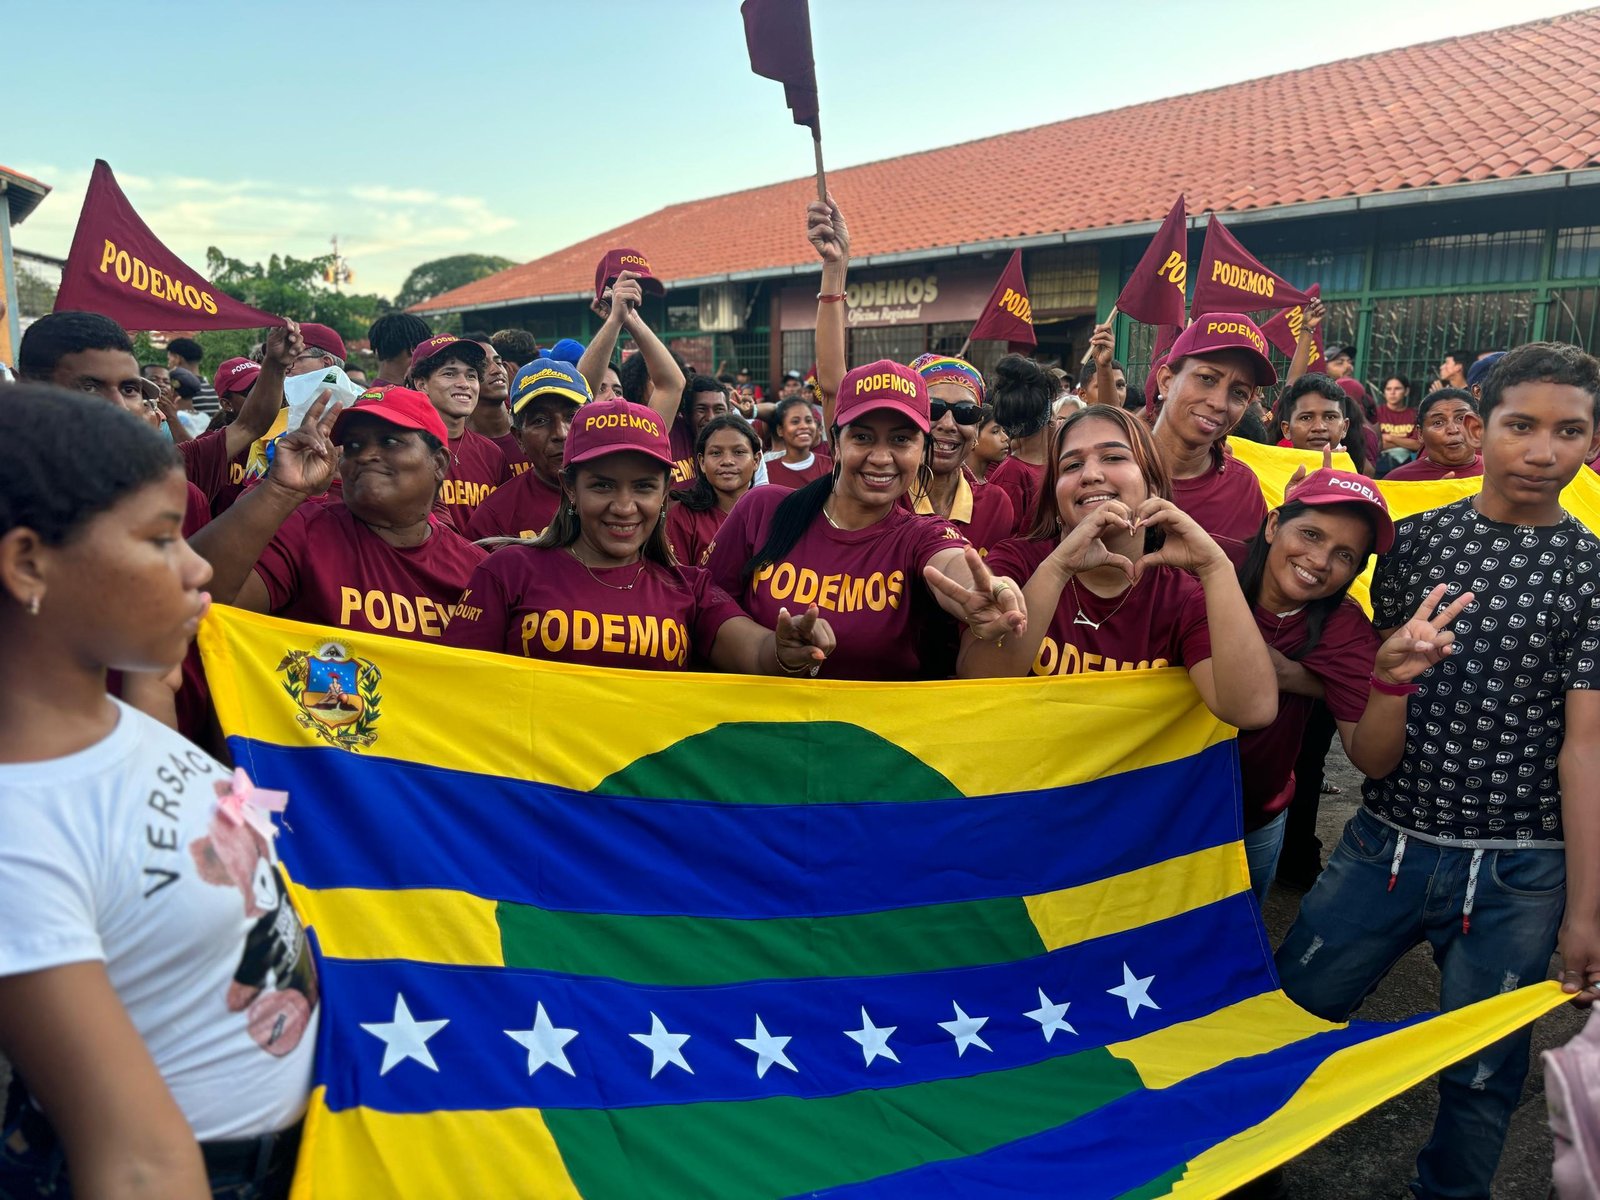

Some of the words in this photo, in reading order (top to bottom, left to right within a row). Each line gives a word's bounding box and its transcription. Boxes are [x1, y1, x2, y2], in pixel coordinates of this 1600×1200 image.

[100, 239, 218, 315] PODEMOS
[846, 275, 939, 309] ODEMOS
[1211, 259, 1275, 298] PODEMOS
[1206, 322, 1265, 353] PODEMOS
[855, 373, 917, 398] PODEMOS
[585, 413, 660, 437] PODEMOS
[439, 479, 498, 507] DEMO
[1327, 476, 1382, 506] PODEM
[753, 560, 905, 613] PODEMOS
[521, 608, 689, 668] PODEMOS
[143, 749, 234, 899] VERSAC
